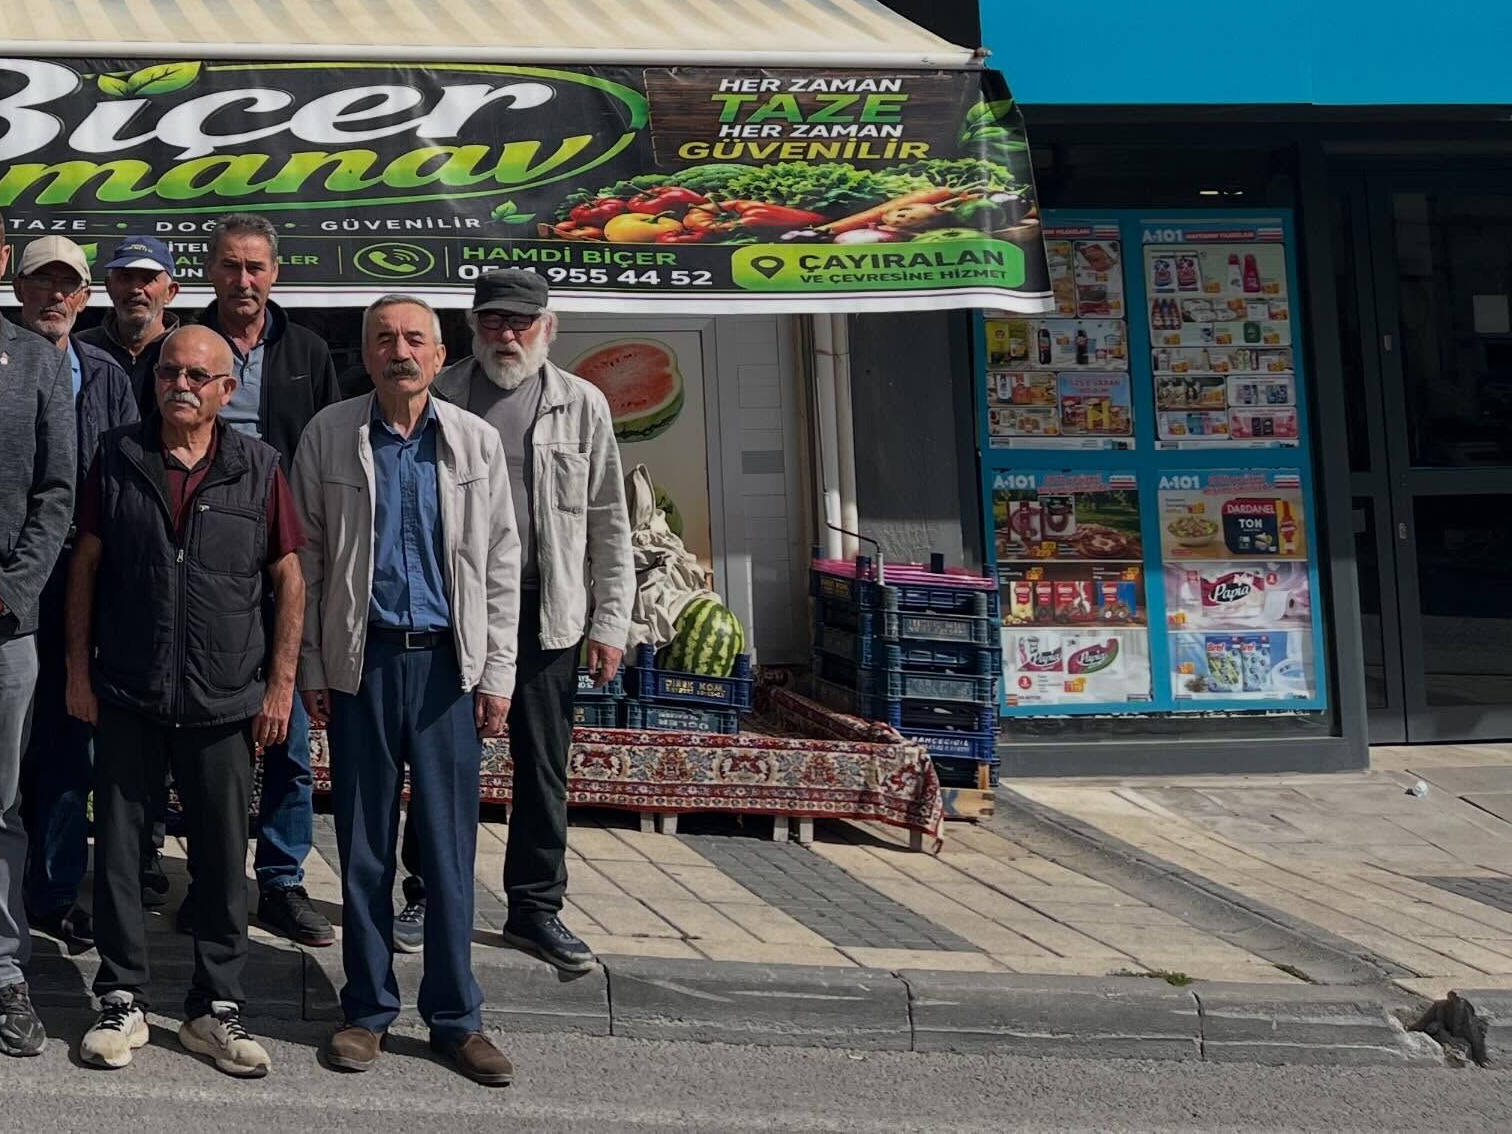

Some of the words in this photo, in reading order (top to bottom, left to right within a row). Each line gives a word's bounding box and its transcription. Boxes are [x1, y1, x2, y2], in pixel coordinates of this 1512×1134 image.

[718, 78, 781, 92] HER
[788, 78, 902, 93] ZAMAN
[710, 93, 909, 123] TAZE
[718, 124, 782, 138] HER
[789, 124, 904, 138] ZAMAN
[677, 137, 930, 160] GÜVENİLİR
[9, 219, 87, 230] TAZE
[320, 216, 481, 231] GÜVENİLİR
[463, 246, 571, 264] HAMDİ
[582, 248, 677, 267] BİÇER
[799, 249, 1006, 272] ÇAYIRALAN
[548, 267, 609, 284] 955
[617, 269, 661, 285] 44
[670, 270, 713, 286] 52
[800, 274, 823, 284] VE
[829, 270, 934, 285] ÇEVRESİNE
[940, 269, 1008, 280] HİZMET
[1227, 504, 1276, 514] DARDANEL
[1238, 518, 1263, 529] TON
[1214, 583, 1250, 602] Papia
